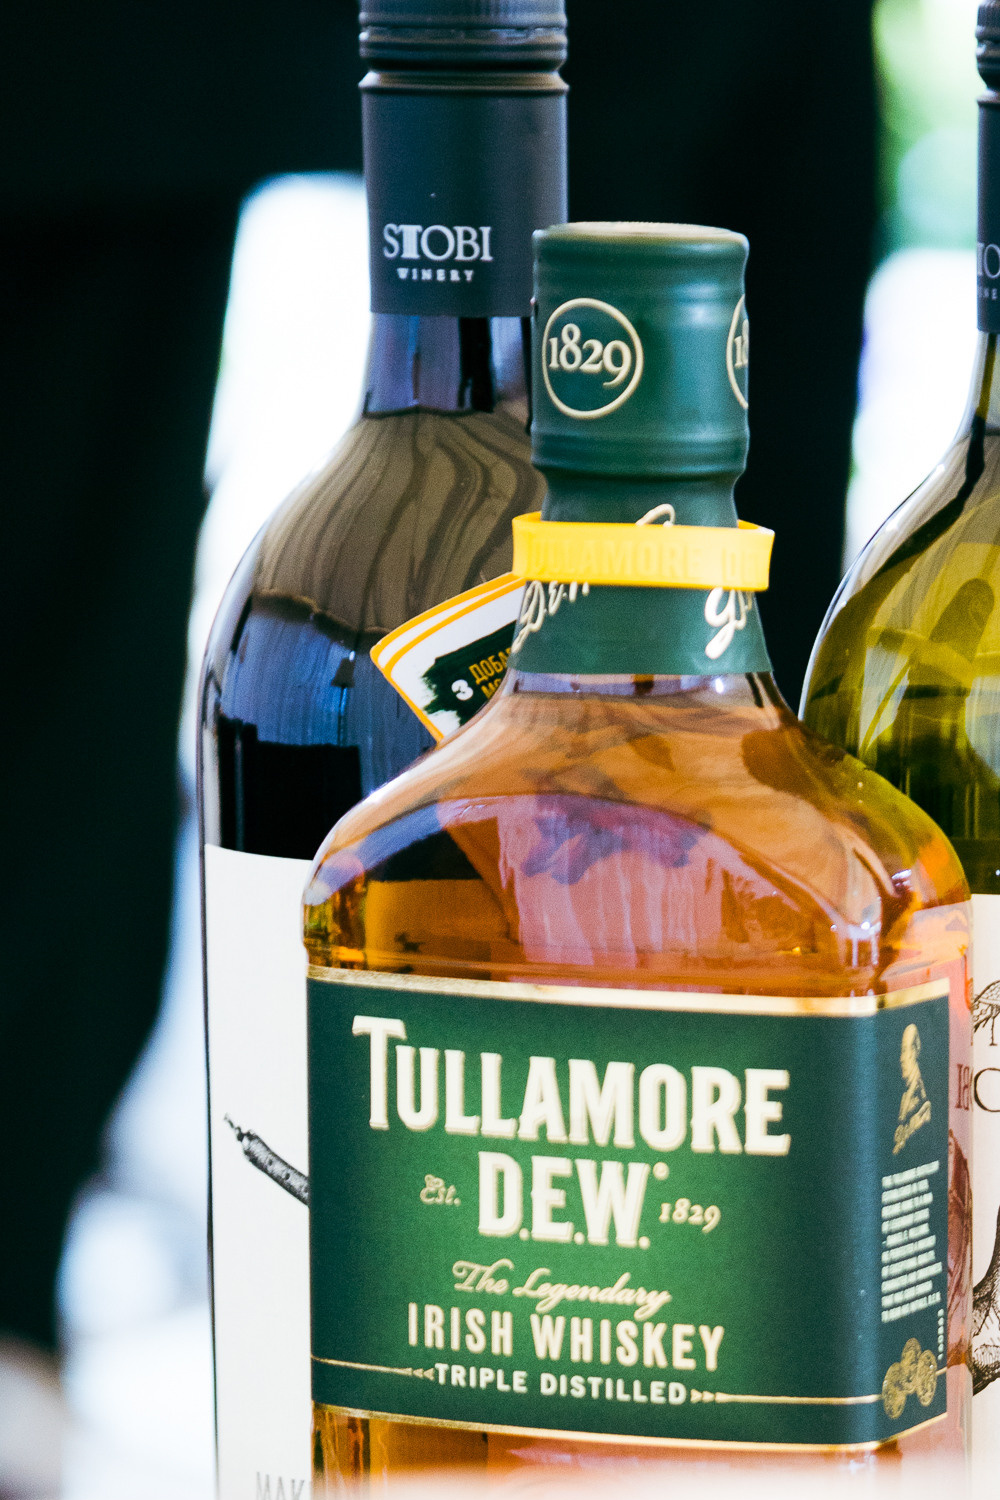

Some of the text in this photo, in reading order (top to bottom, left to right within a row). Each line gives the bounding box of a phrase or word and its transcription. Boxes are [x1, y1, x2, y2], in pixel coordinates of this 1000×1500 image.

[383, 223, 493, 261] STOBI
[397, 267, 474, 281] WINERY
[548, 323, 632, 388] 1829
[352, 1014, 791, 1156] TULLAMORE
[419, 1173, 461, 1207] Est.
[658, 1197, 722, 1234] 1829
[452, 1258, 672, 1322] The Legendary
[408, 1302, 724, 1372] IRISH WHISKEY
[434, 1362, 687, 1405] TRIPLE DISTILLED
